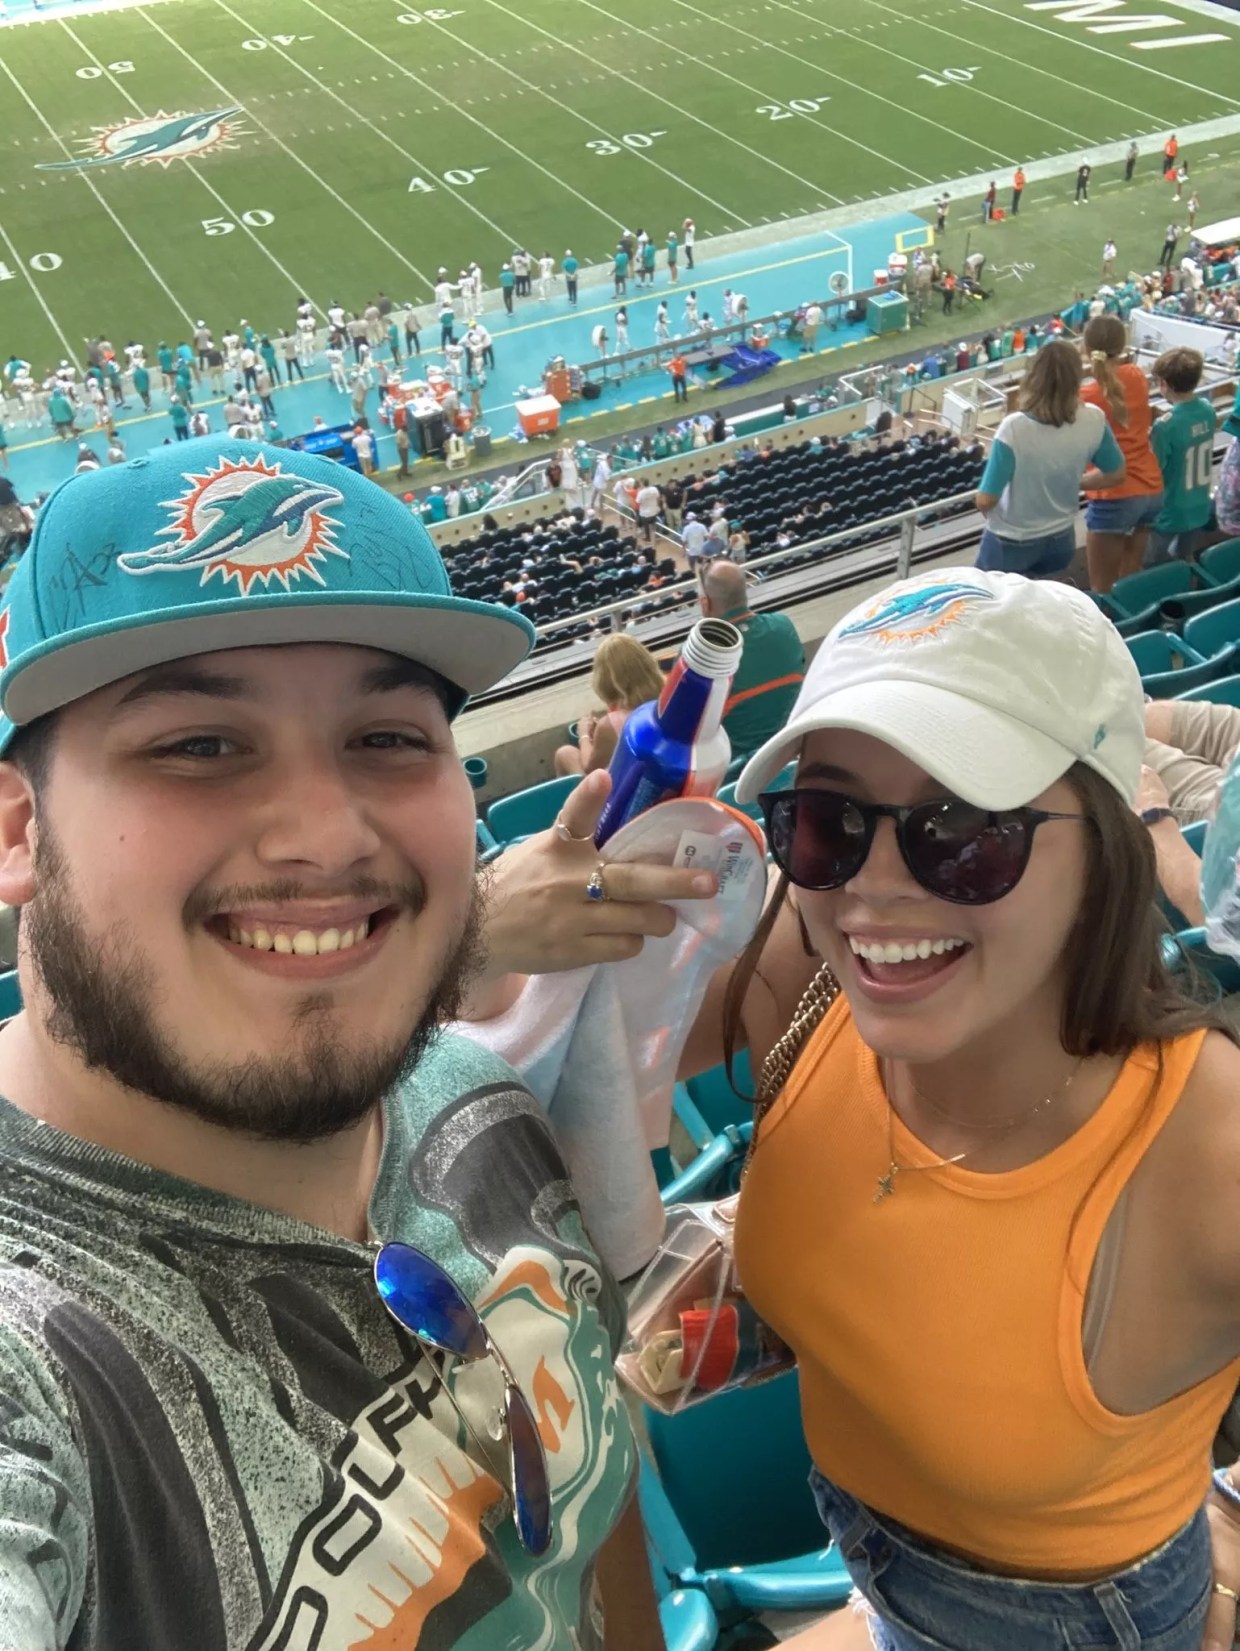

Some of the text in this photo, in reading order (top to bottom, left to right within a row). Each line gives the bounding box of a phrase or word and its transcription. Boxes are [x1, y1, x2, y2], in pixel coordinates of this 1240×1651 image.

[75, 60, 136, 80] 50
[916, 67, 975, 89] 10
[755, 99, 820, 121] 20
[586, 133, 654, 157] 30
[407, 168, 477, 194] 40
[201, 208, 275, 237] 50
